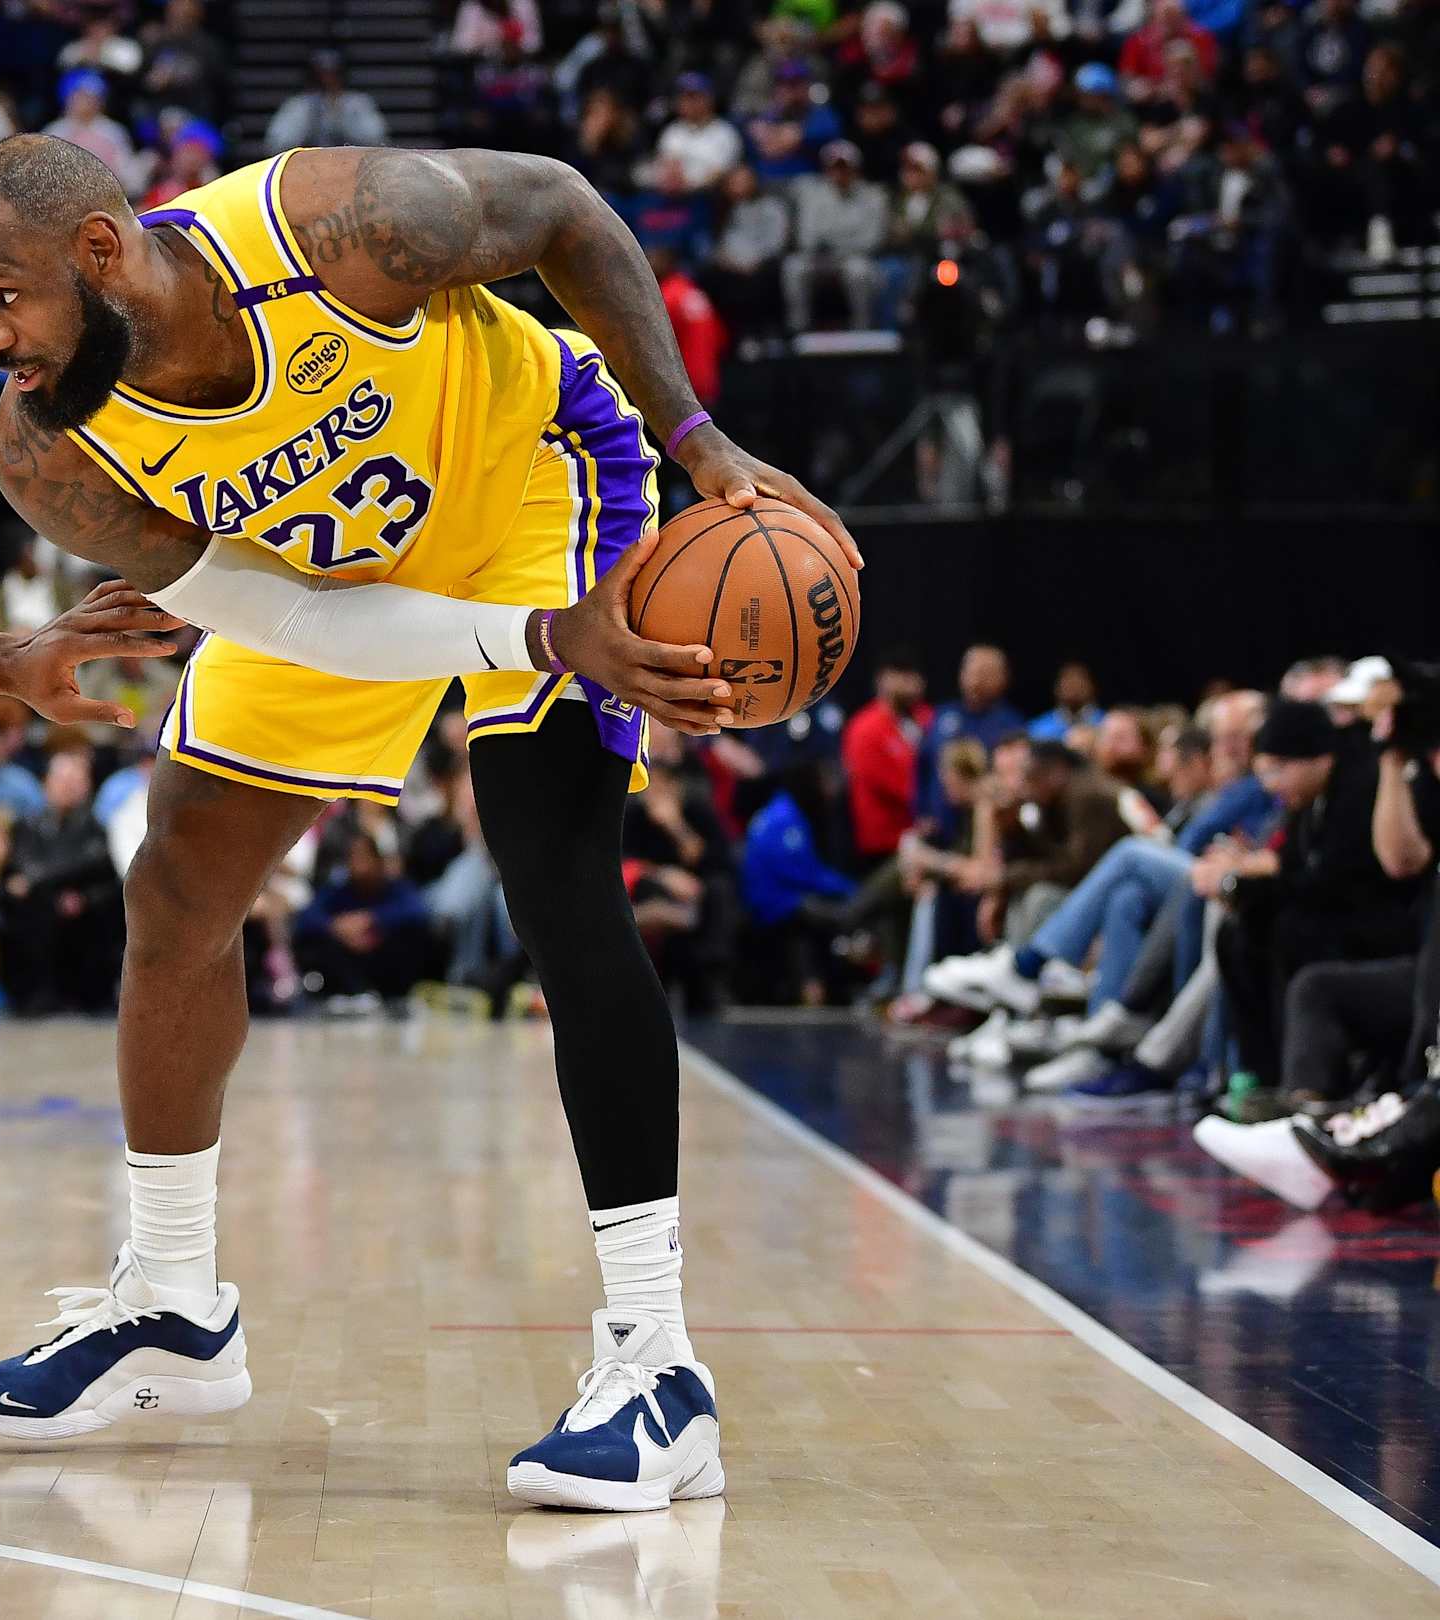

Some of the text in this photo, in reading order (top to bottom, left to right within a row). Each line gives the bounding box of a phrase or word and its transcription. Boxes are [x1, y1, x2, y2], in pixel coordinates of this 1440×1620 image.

[267, 281, 288, 299] 44
[290, 338, 342, 386] bibigo
[171, 375, 394, 538] LAKERS
[255, 453, 435, 571] 23
